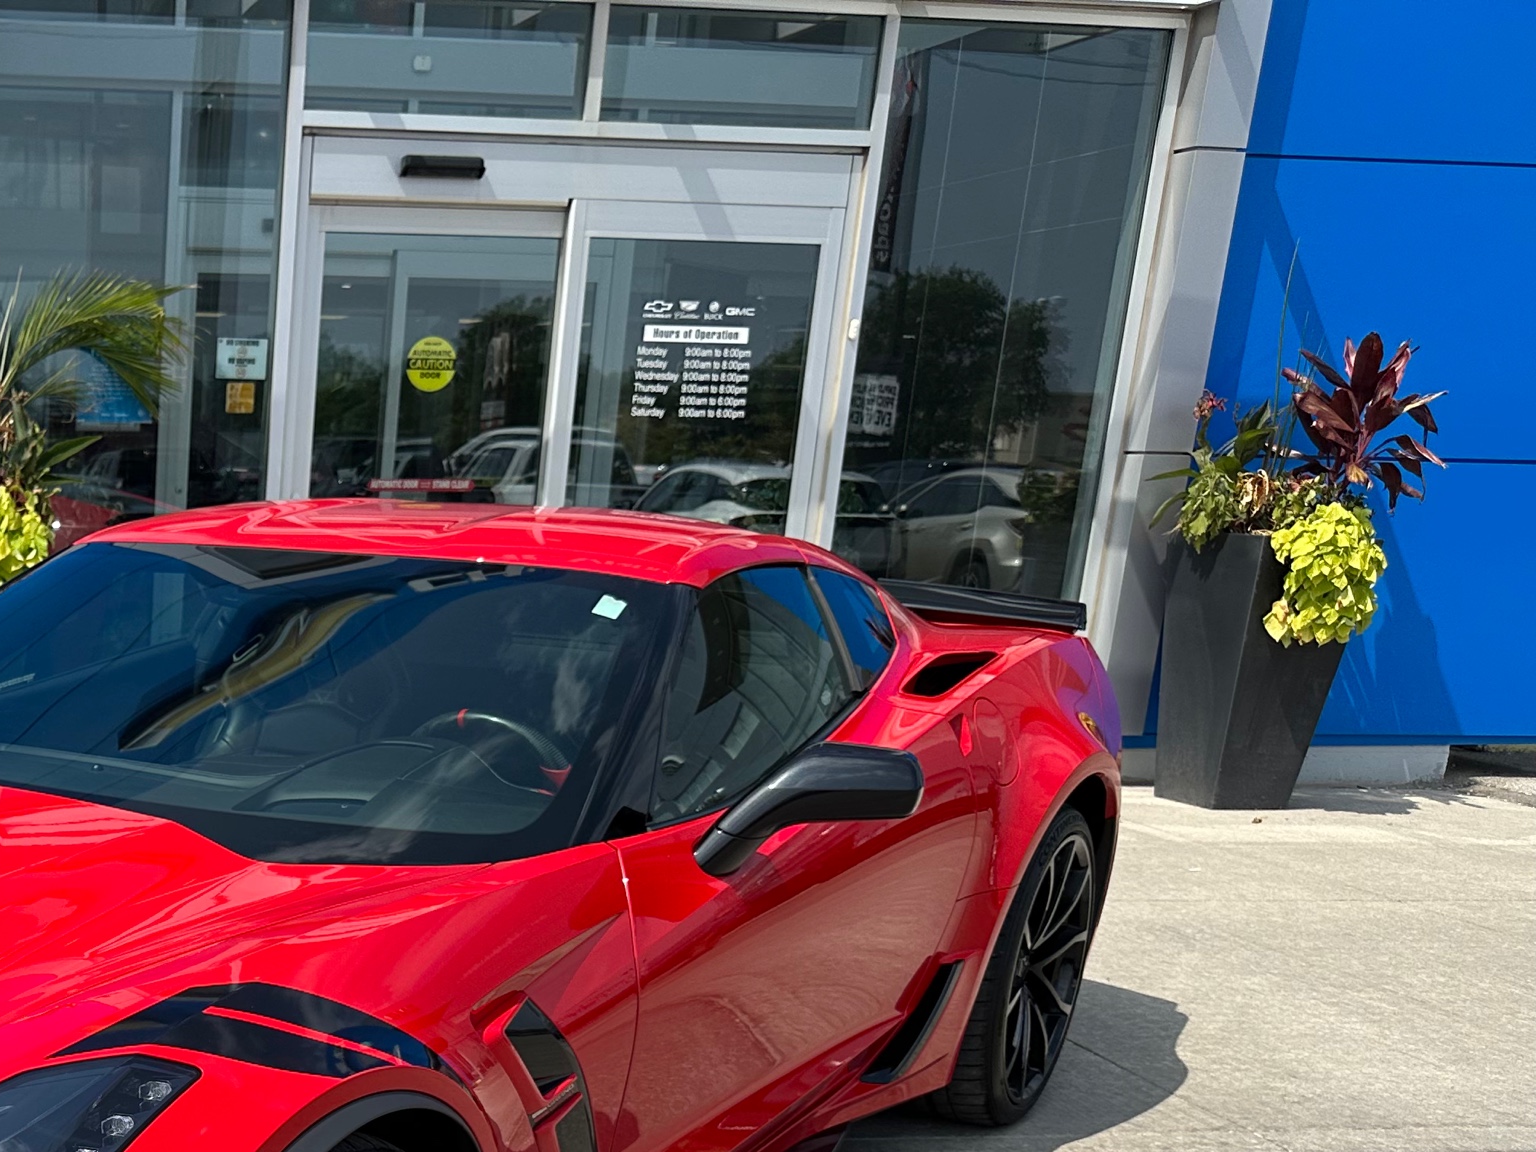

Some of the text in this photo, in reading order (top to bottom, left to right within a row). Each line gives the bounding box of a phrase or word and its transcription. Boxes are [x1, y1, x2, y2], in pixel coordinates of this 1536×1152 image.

[726, 307, 755, 316] GMC
[653, 328, 739, 340] Hours of Operation
[637, 346, 668, 357] Monday
[714, 348, 721, 357] to
[409, 359, 454, 369] CAUTION
[636, 359, 668, 370] Tuesday
[713, 361, 720, 370] to
[635, 371, 679, 382] Wednesday
[712, 373, 719, 382] to
[634, 383, 668, 395] Thursday
[710, 385, 718, 394] to
[632, 395, 656, 406] Friday
[709, 397, 716, 405] to
[631, 407, 665, 419] Saturday
[707, 409, 715, 418] to
